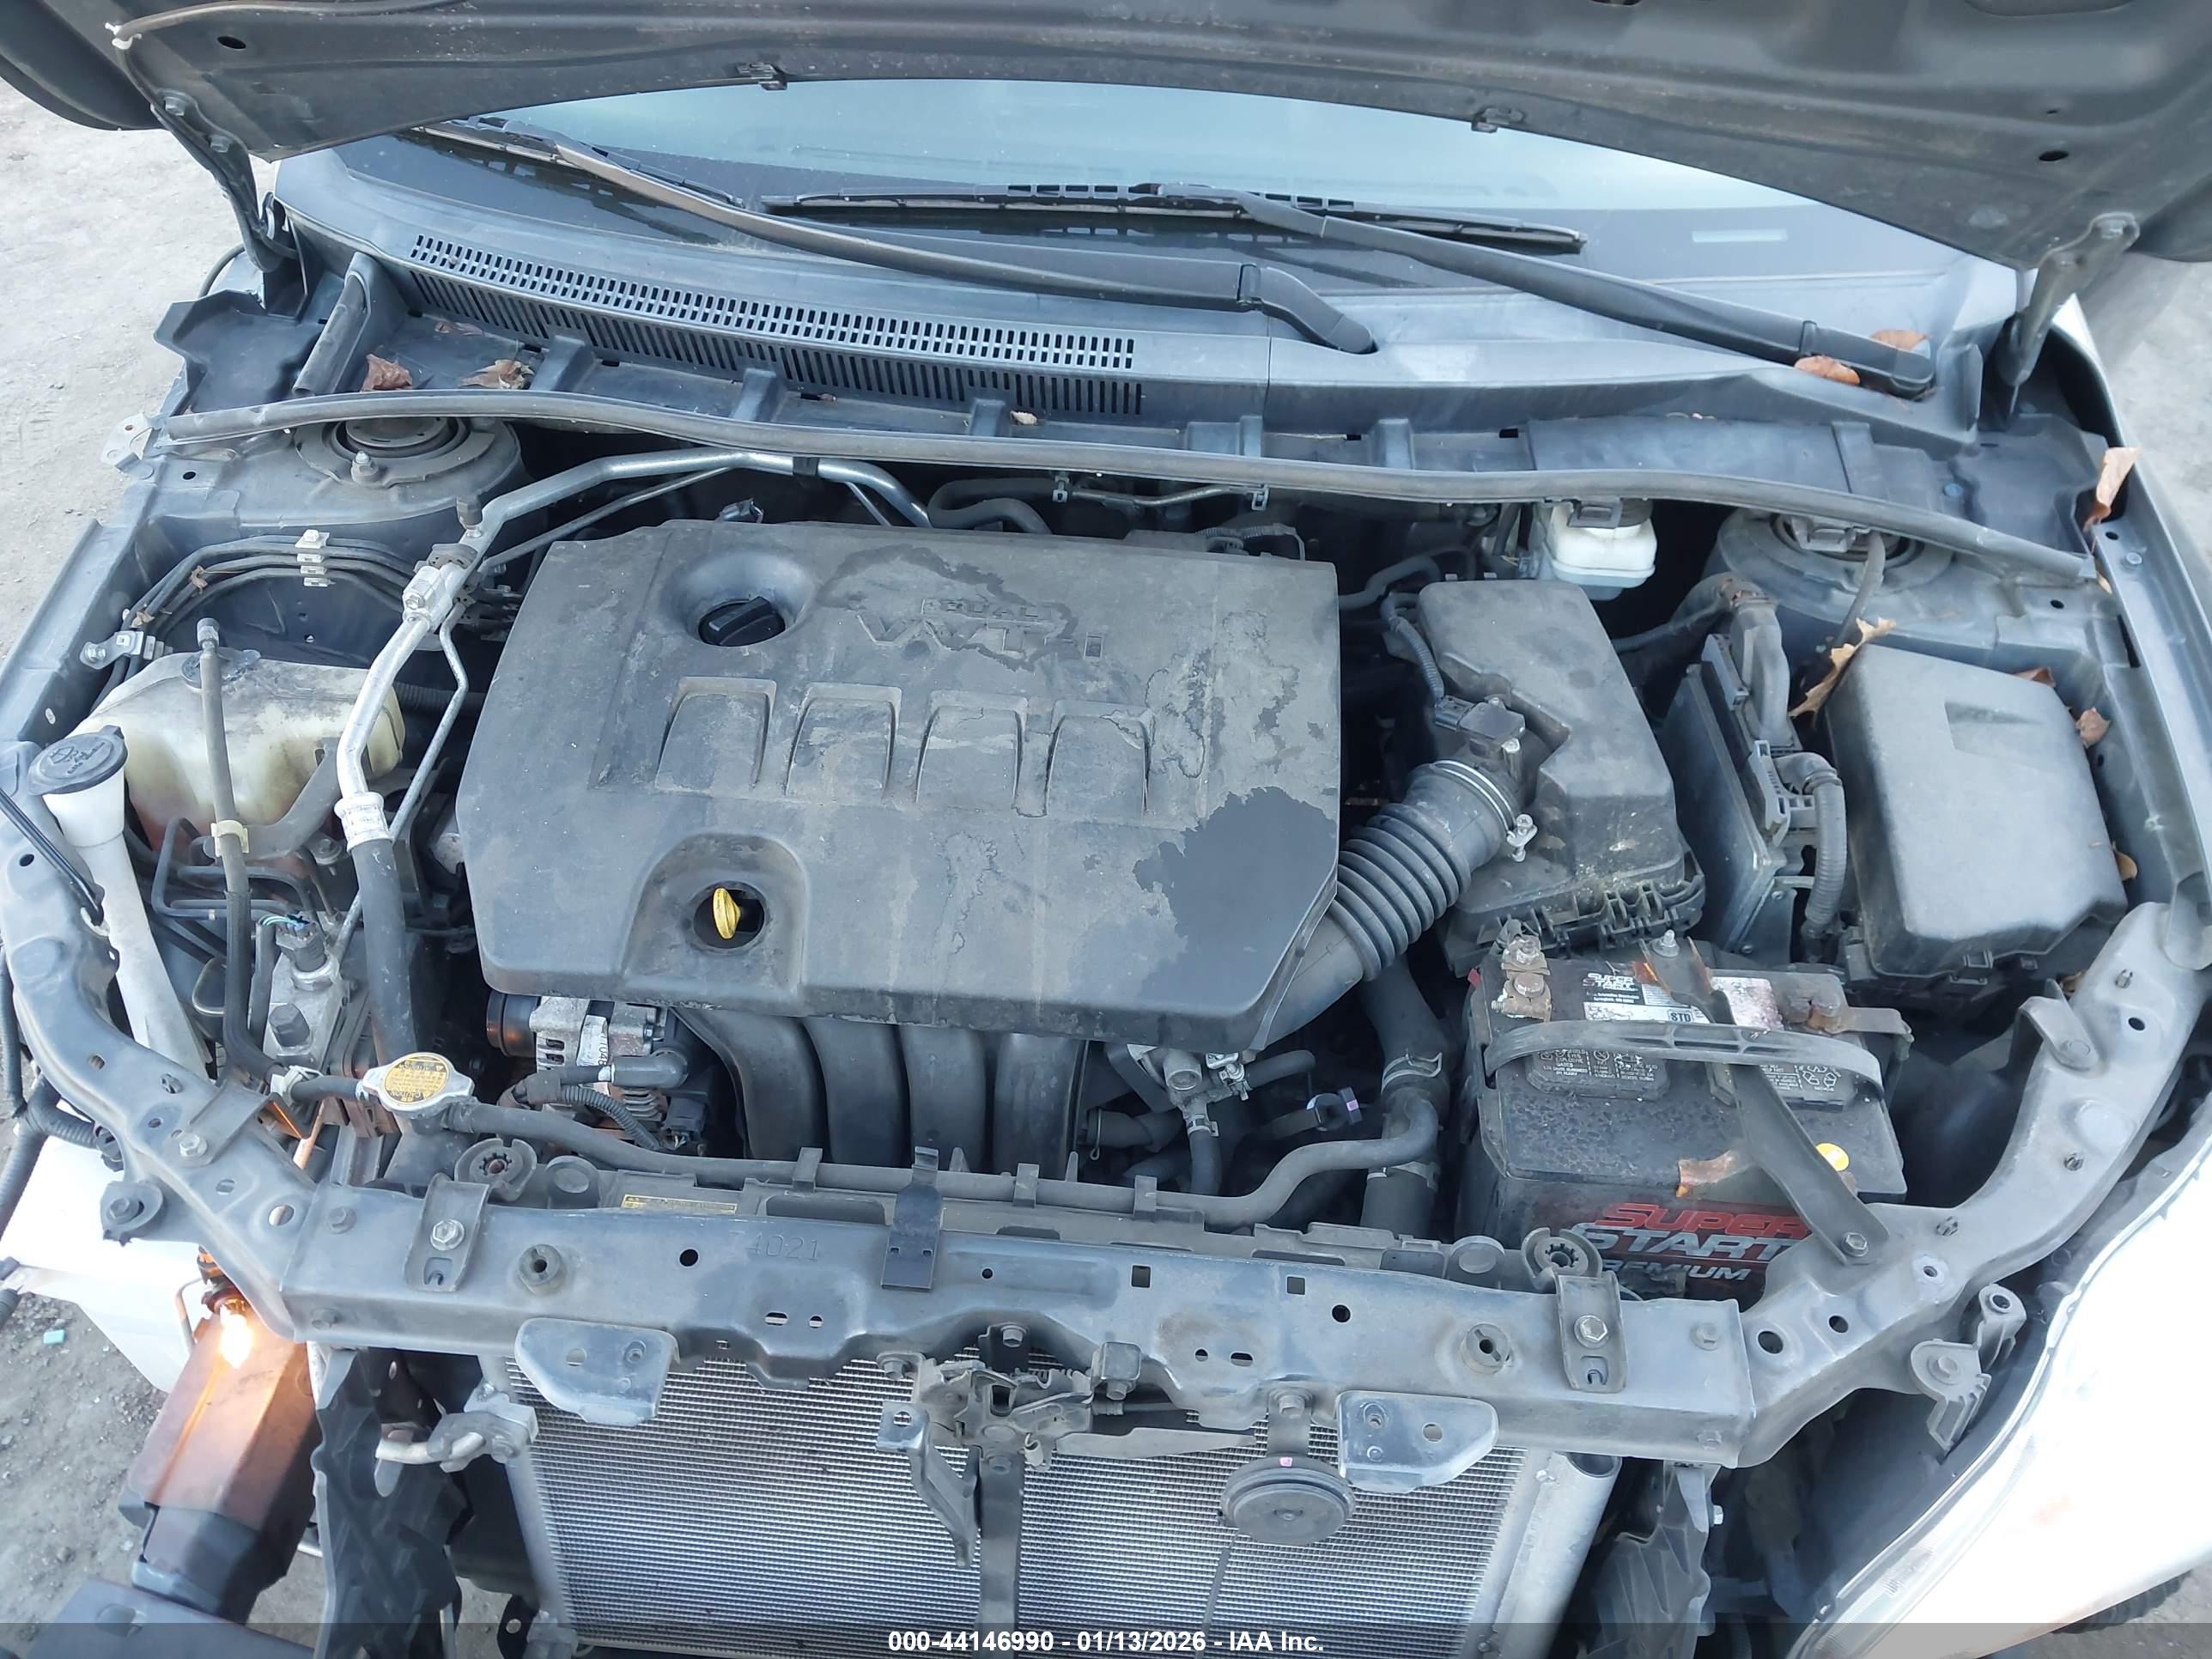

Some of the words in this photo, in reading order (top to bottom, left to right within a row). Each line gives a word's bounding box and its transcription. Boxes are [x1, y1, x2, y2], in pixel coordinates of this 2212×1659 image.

[1669, 1012, 1692, 1023] STD
[1594, 1202, 1814, 1239] SUPER
[1571, 1222, 1808, 1261] START
[1602, 1259, 1753, 1281] REMIUM
